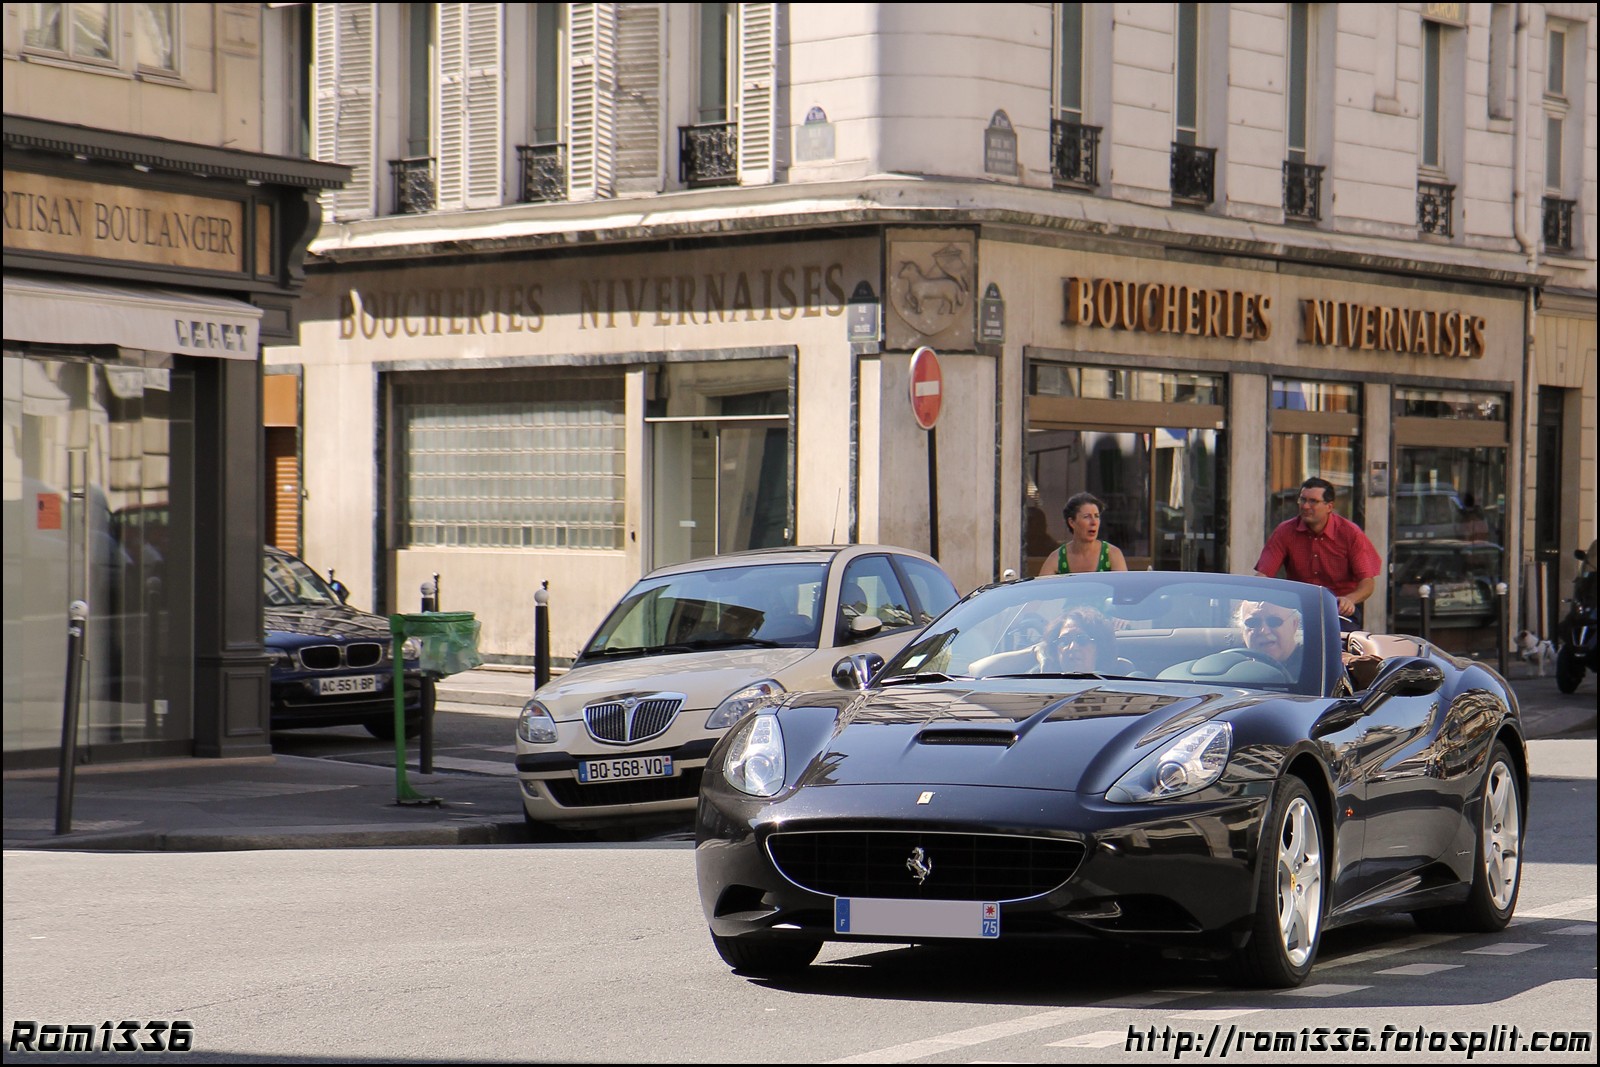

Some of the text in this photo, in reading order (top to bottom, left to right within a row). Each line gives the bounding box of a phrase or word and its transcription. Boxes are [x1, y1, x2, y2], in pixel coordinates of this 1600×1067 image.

[95, 202, 235, 255] BOULANGER
[339, 263, 846, 340] BOUCHERIES NIVERNAISES
[1076, 276, 1486, 360] BOUCHERIES NIVERNAISES
[840, 918, 846, 927] F
[983, 921, 997, 934] 75
